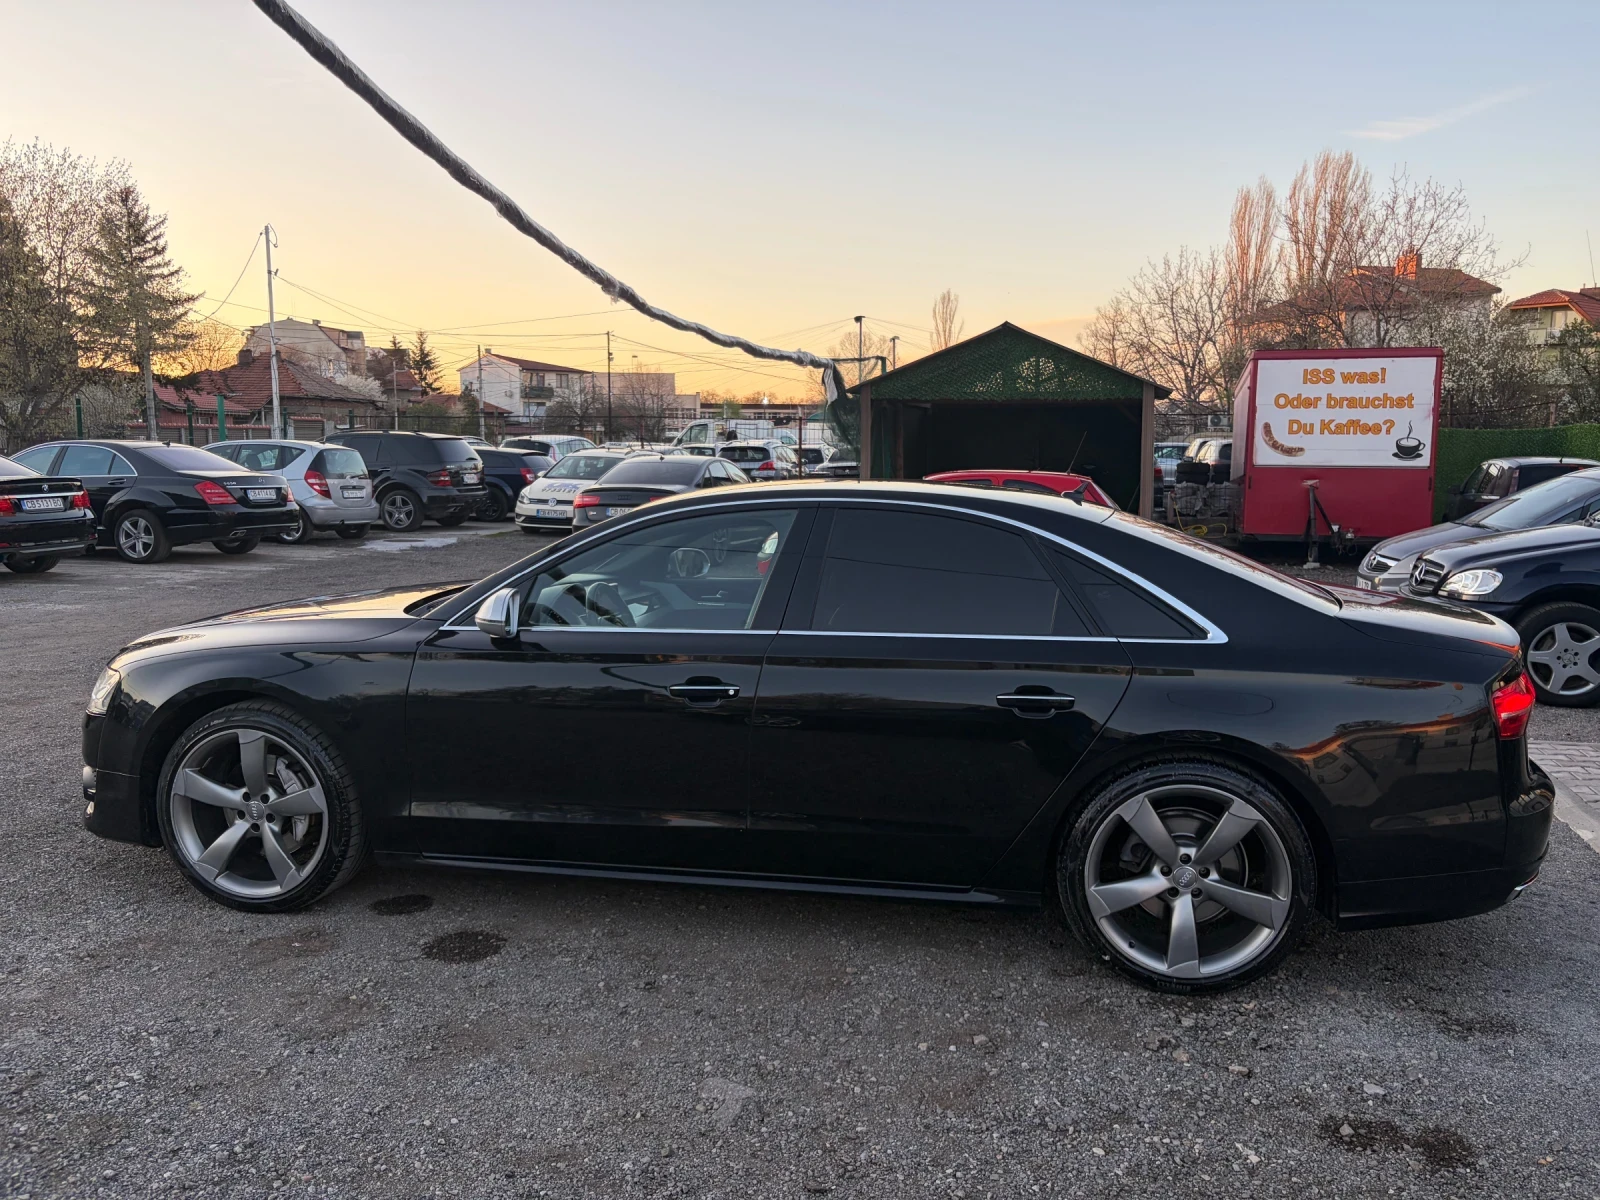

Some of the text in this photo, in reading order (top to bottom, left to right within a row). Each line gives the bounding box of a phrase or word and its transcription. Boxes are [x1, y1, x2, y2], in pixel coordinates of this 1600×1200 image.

[1302, 367, 1387, 385] ISS was!
[1274, 392, 1414, 409] Oder brauchst
[1287, 418, 1396, 435] Du Kaffee?
